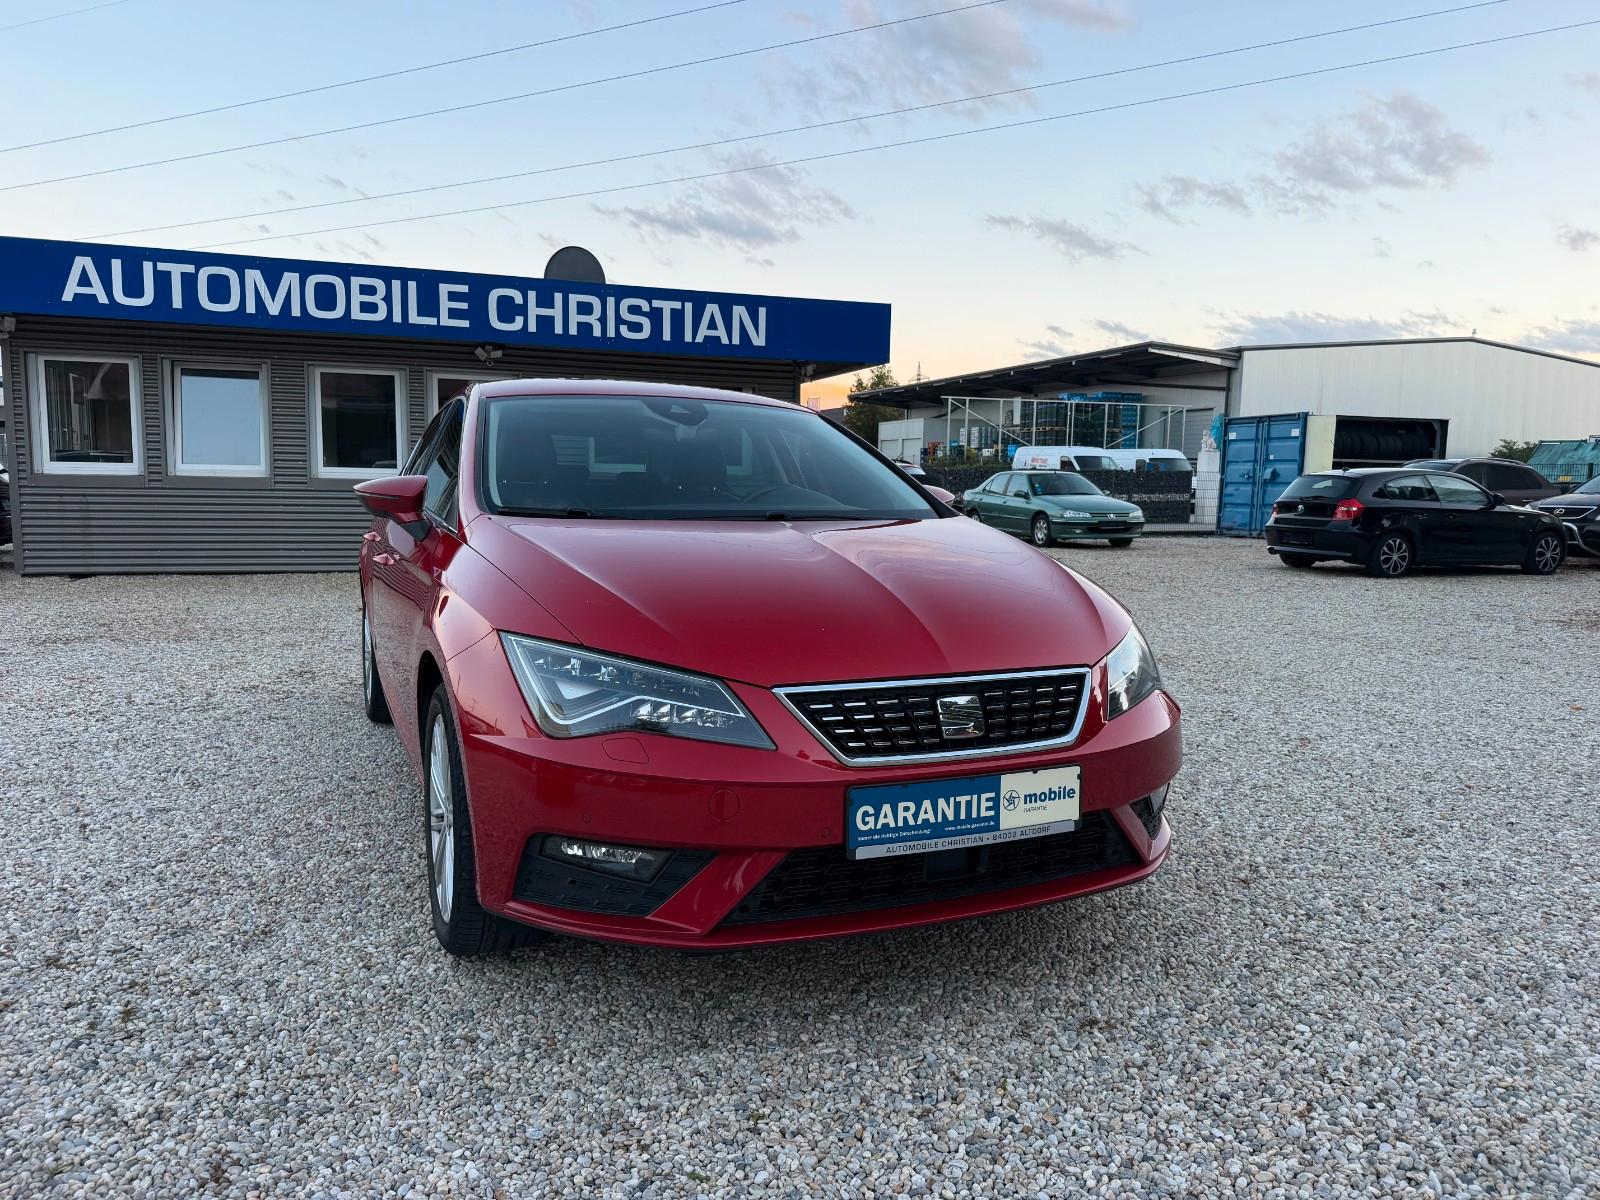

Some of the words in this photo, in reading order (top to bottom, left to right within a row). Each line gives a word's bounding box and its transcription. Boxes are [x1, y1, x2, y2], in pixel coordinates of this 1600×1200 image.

[61, 256, 471, 329] AUTOMOBILE
[487, 287, 767, 347] CHRISTIAN
[1023, 785, 1076, 805] mobile
[1023, 805, 1048, 813] GARANTIE
[855, 792, 996, 831] GARANTIE
[886, 841, 939, 854] AUTOMOBILE
[941, 835, 984, 848] CHRISTIAN
[992, 831, 1017, 841] 84032
[1019, 826, 1051, 837] ALTDORF
